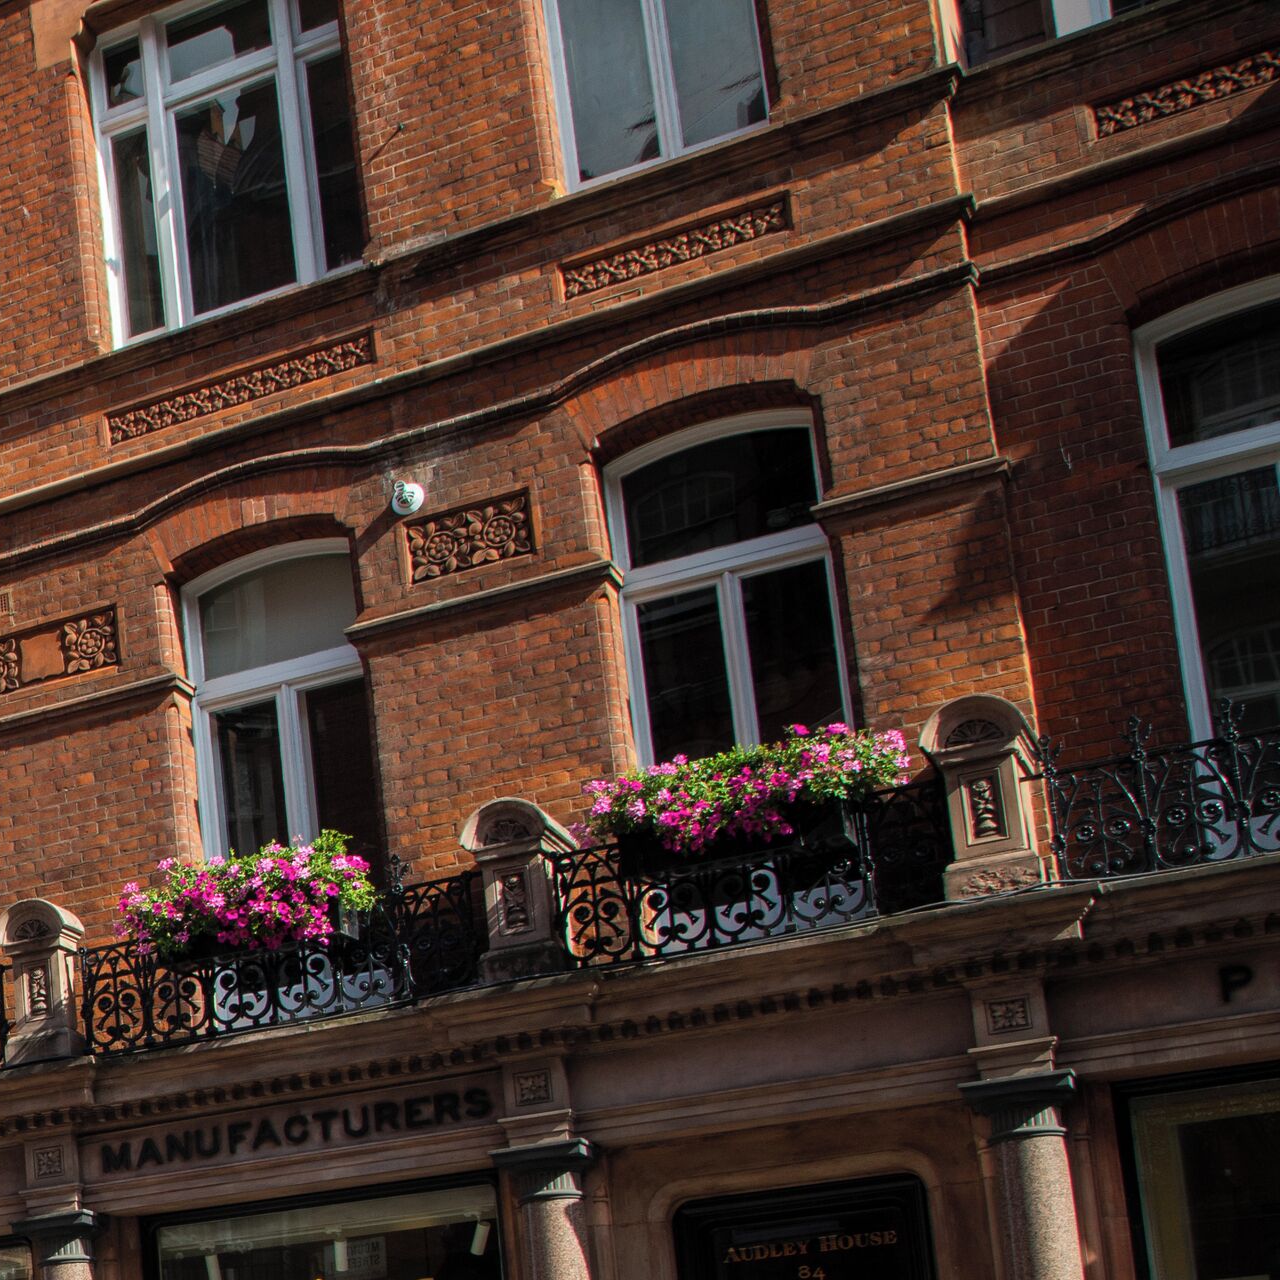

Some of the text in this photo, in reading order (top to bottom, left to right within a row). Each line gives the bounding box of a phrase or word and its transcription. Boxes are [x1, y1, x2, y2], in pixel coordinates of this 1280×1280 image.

[100, 1087, 494, 1174] MANUFACTURERS
[723, 1230, 898, 1264] AUDLEY HOUSE
[798, 1265, 826, 1280] 84
